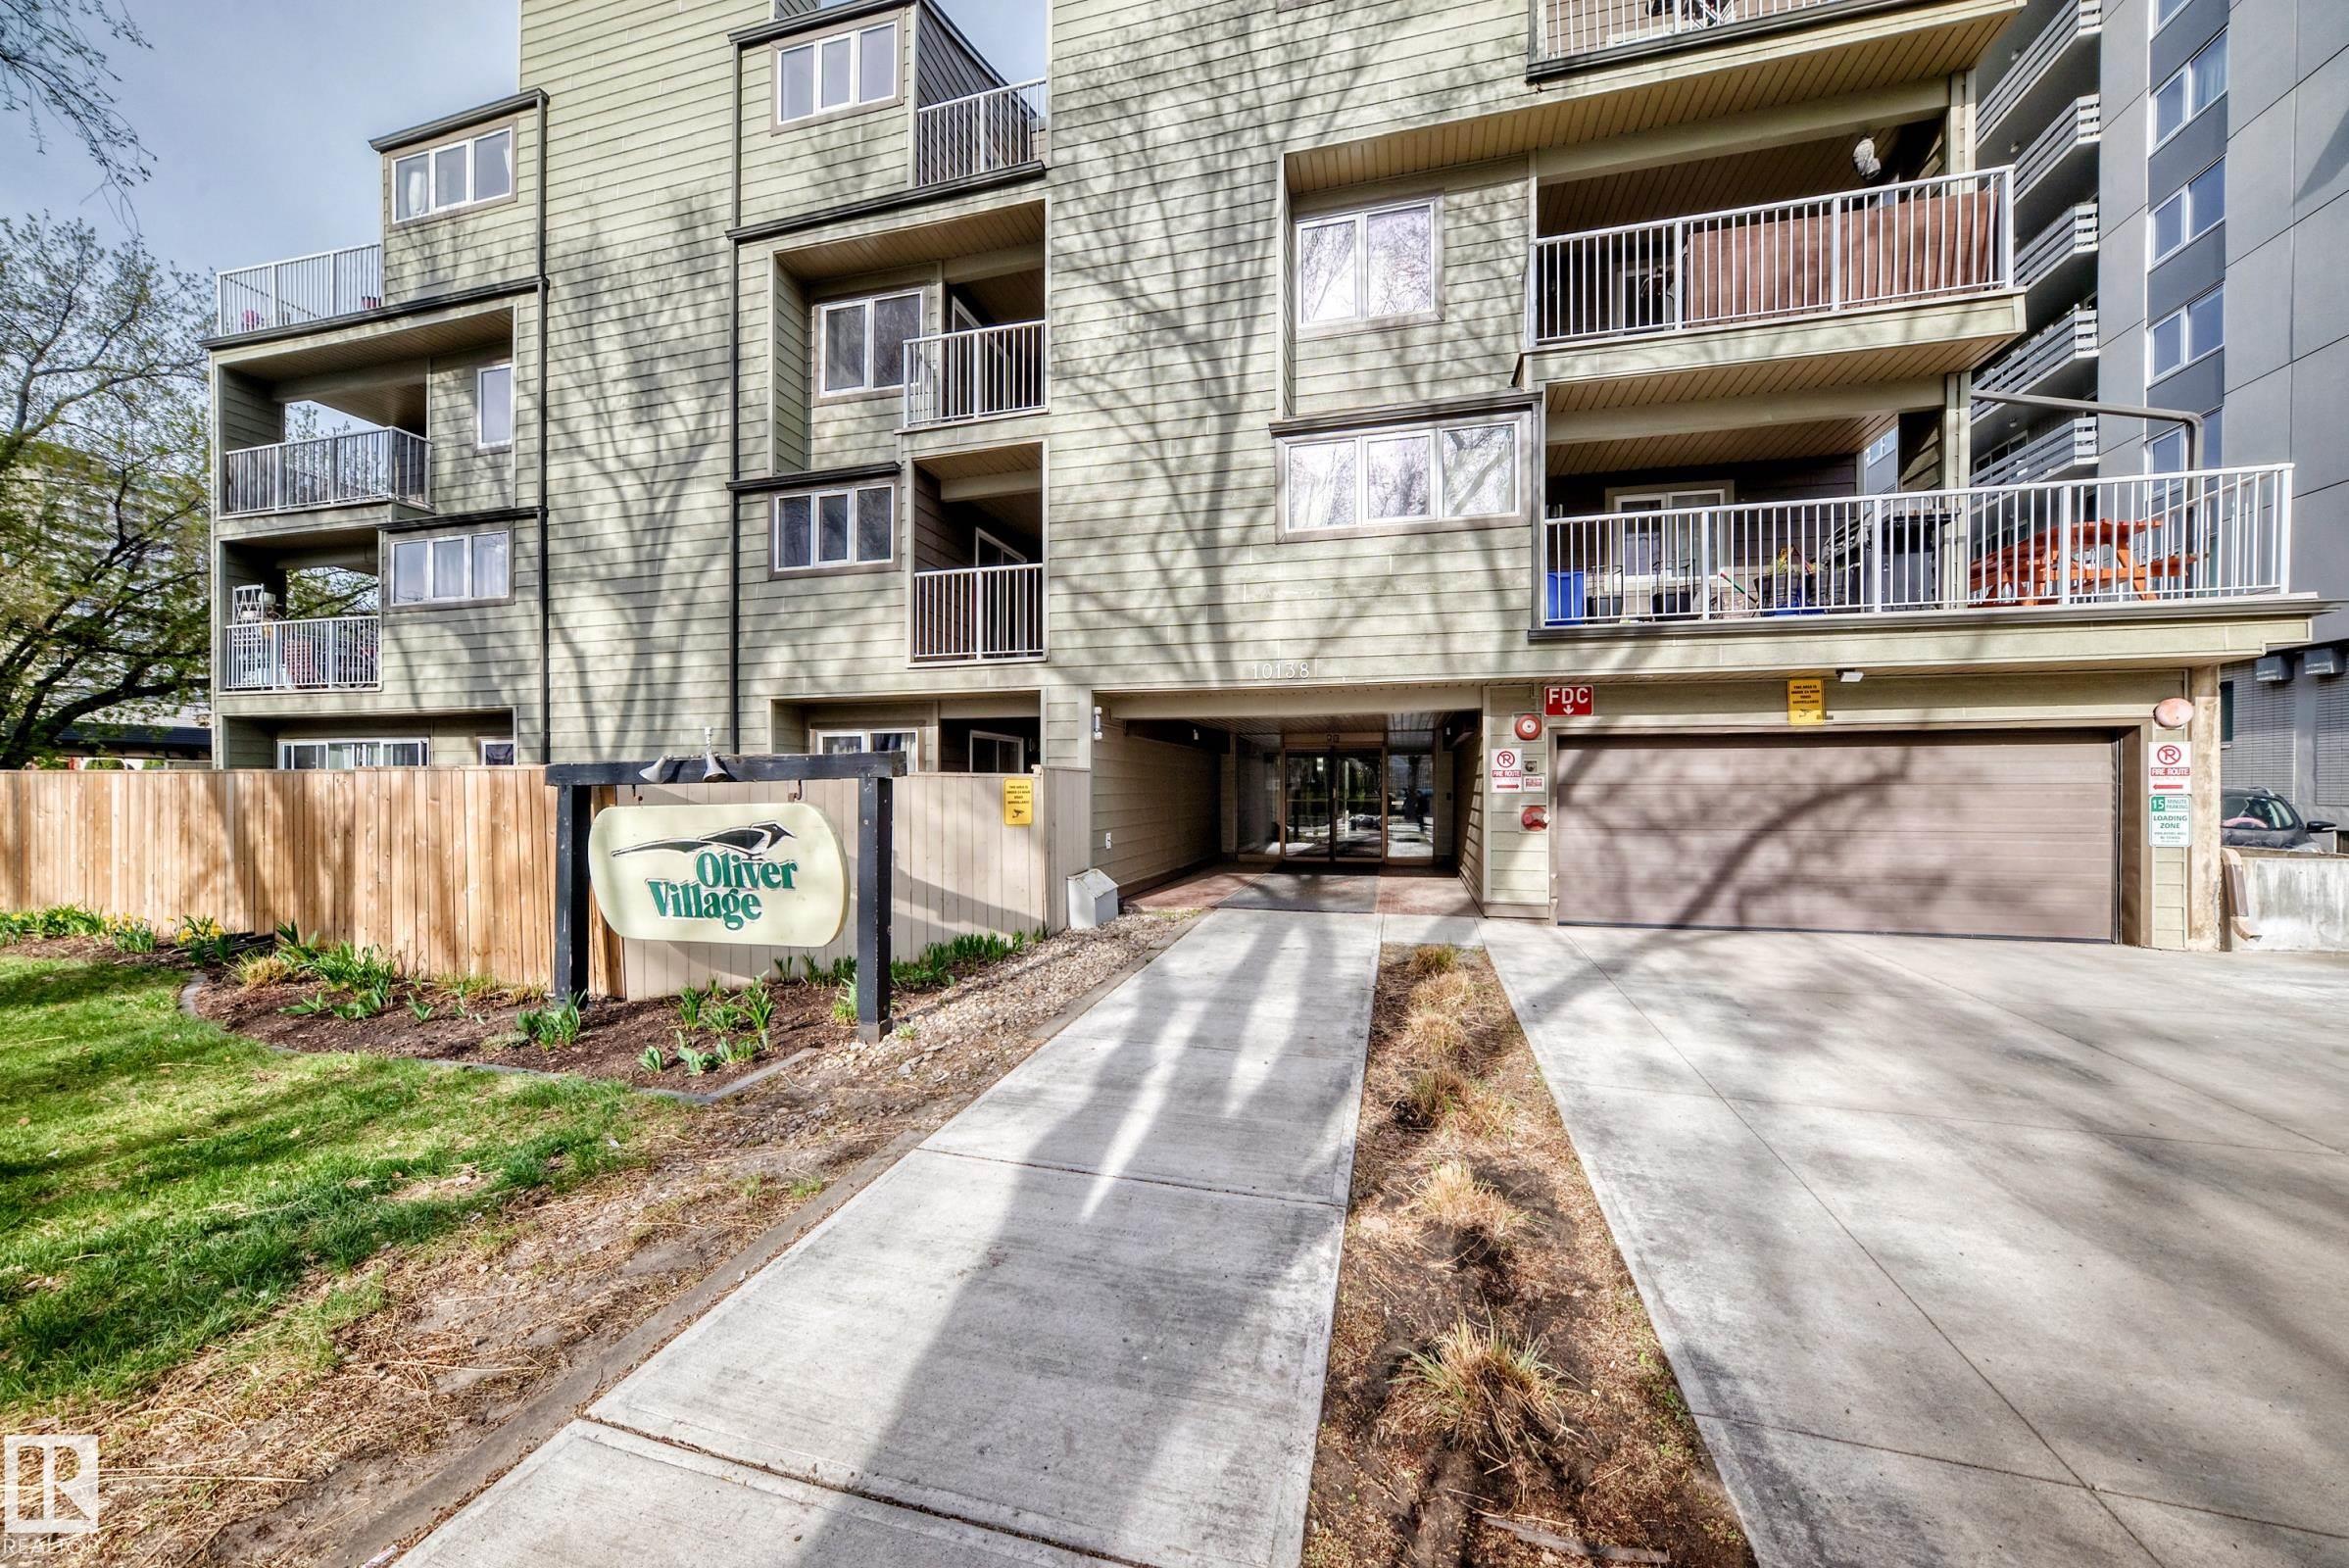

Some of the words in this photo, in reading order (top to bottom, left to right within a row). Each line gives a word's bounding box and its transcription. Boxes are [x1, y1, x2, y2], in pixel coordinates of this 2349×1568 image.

[1252, 662, 1309, 679] 10138
[1548, 688, 1589, 705] FDC
[2152, 799, 2165, 809] 15
[695, 850, 798, 890] Oliver
[647, 878, 762, 931] Village
